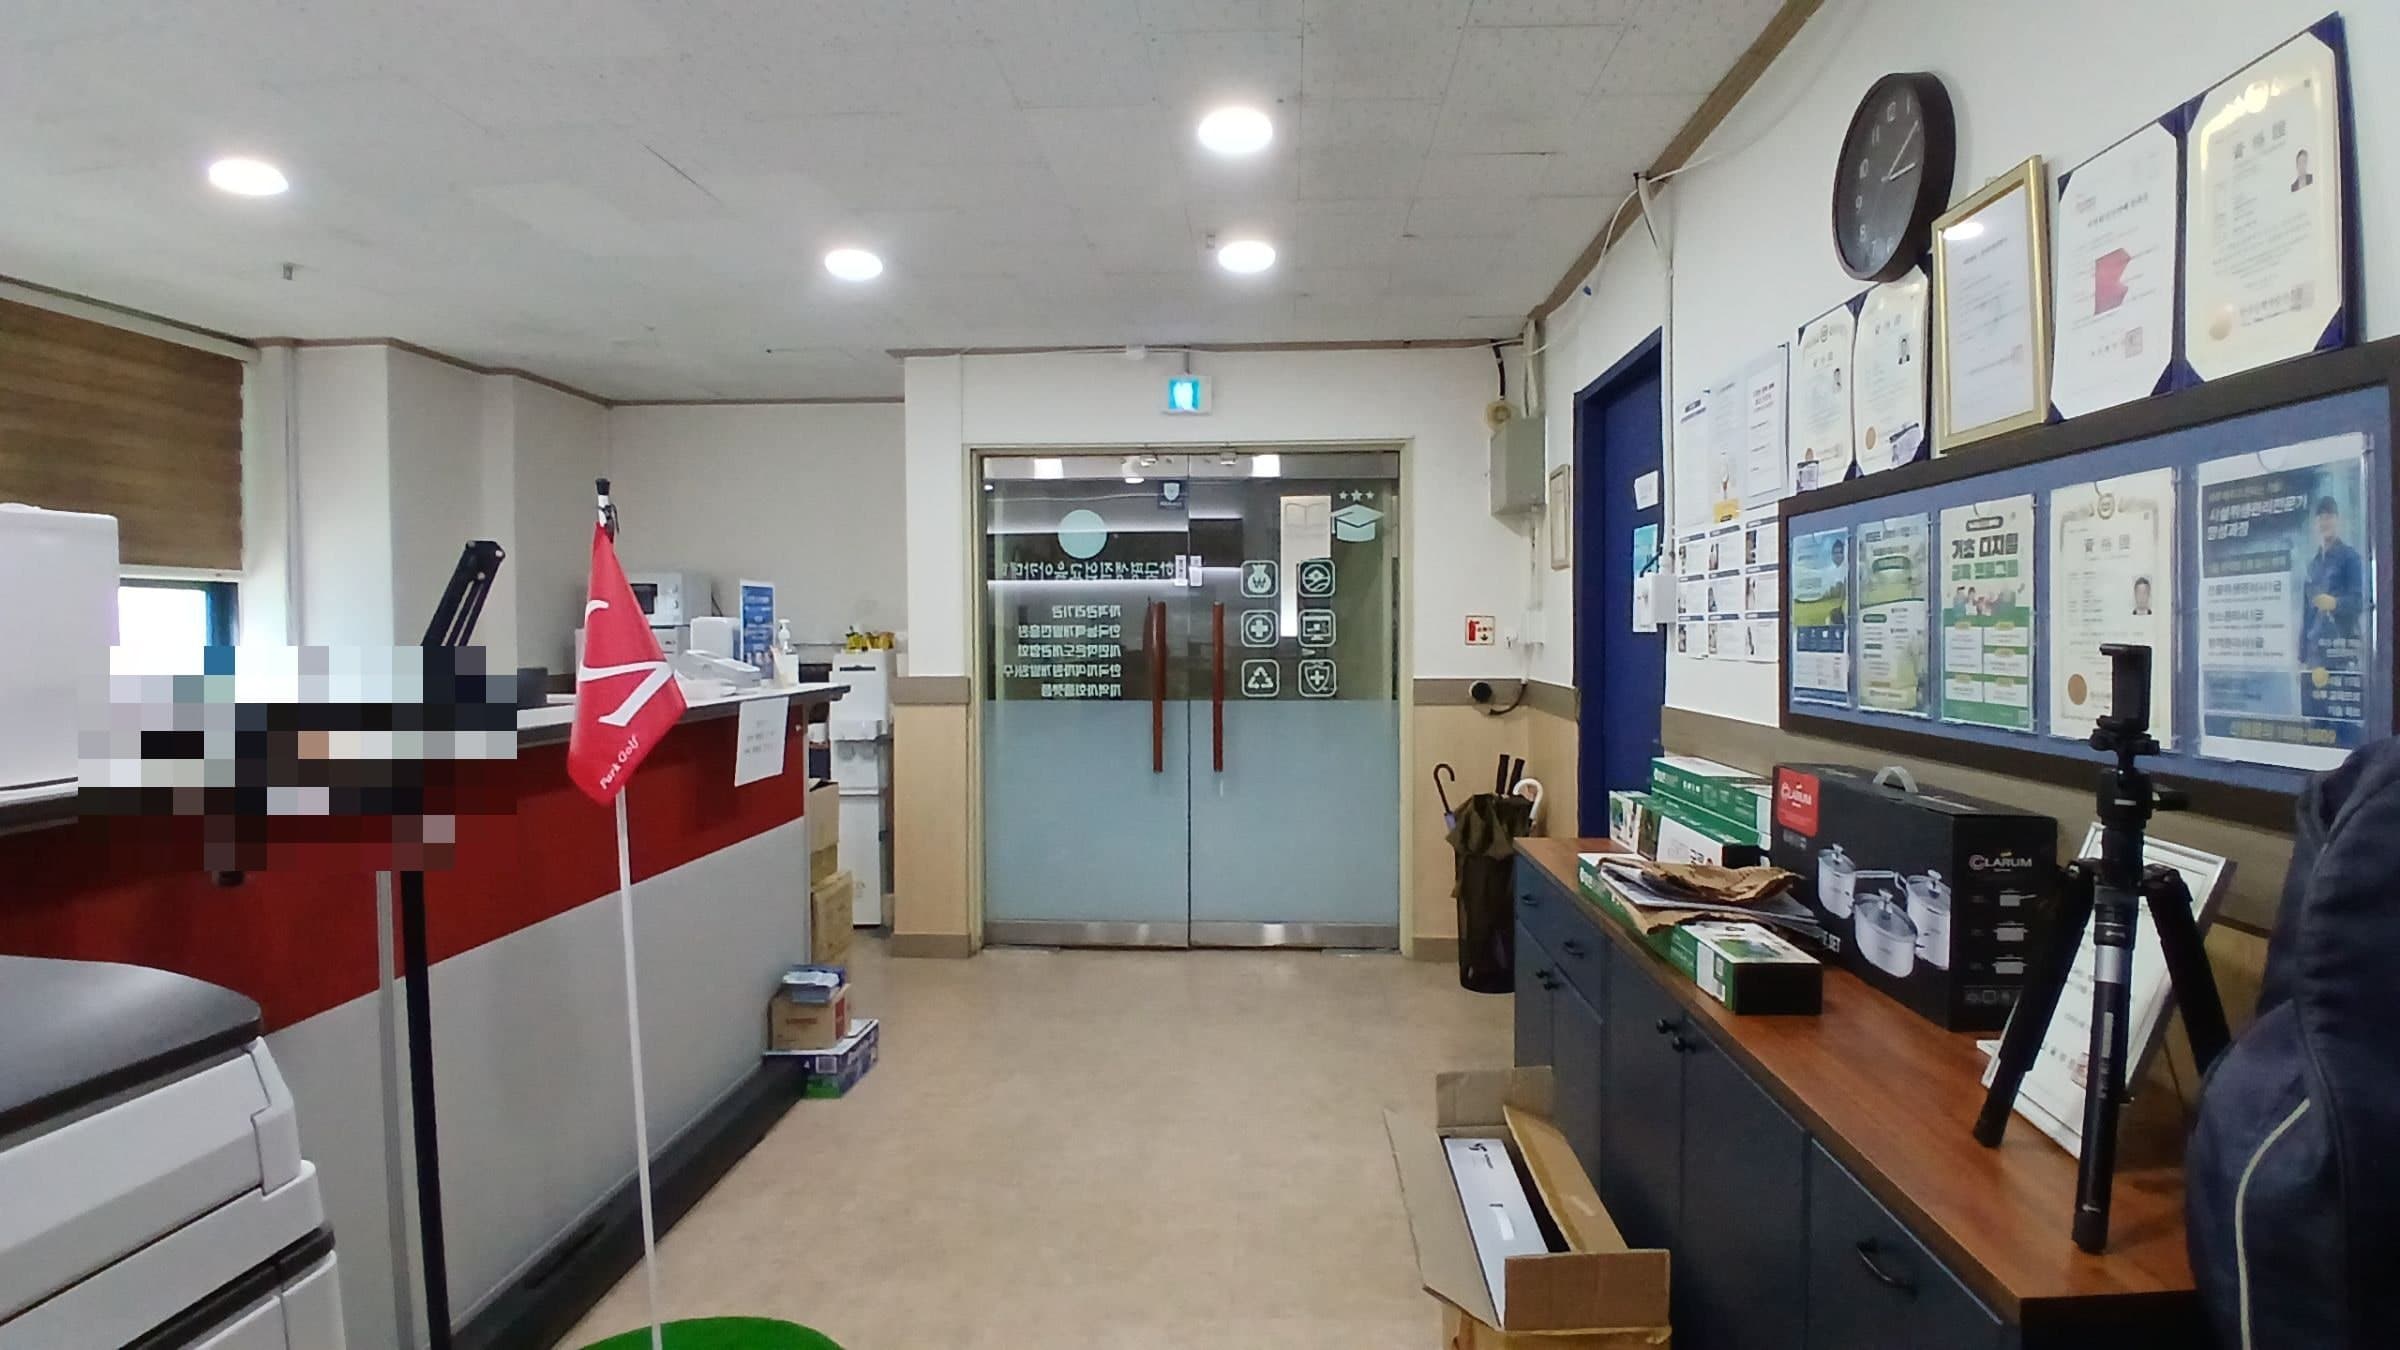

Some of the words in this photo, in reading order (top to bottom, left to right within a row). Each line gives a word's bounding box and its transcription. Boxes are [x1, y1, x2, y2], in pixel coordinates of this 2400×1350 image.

[1951, 538, 1975, 560] 기초
[599, 760, 622, 790] Park
[617, 732, 640, 762] Golf
[1968, 853, 2033, 872] CLARUM
